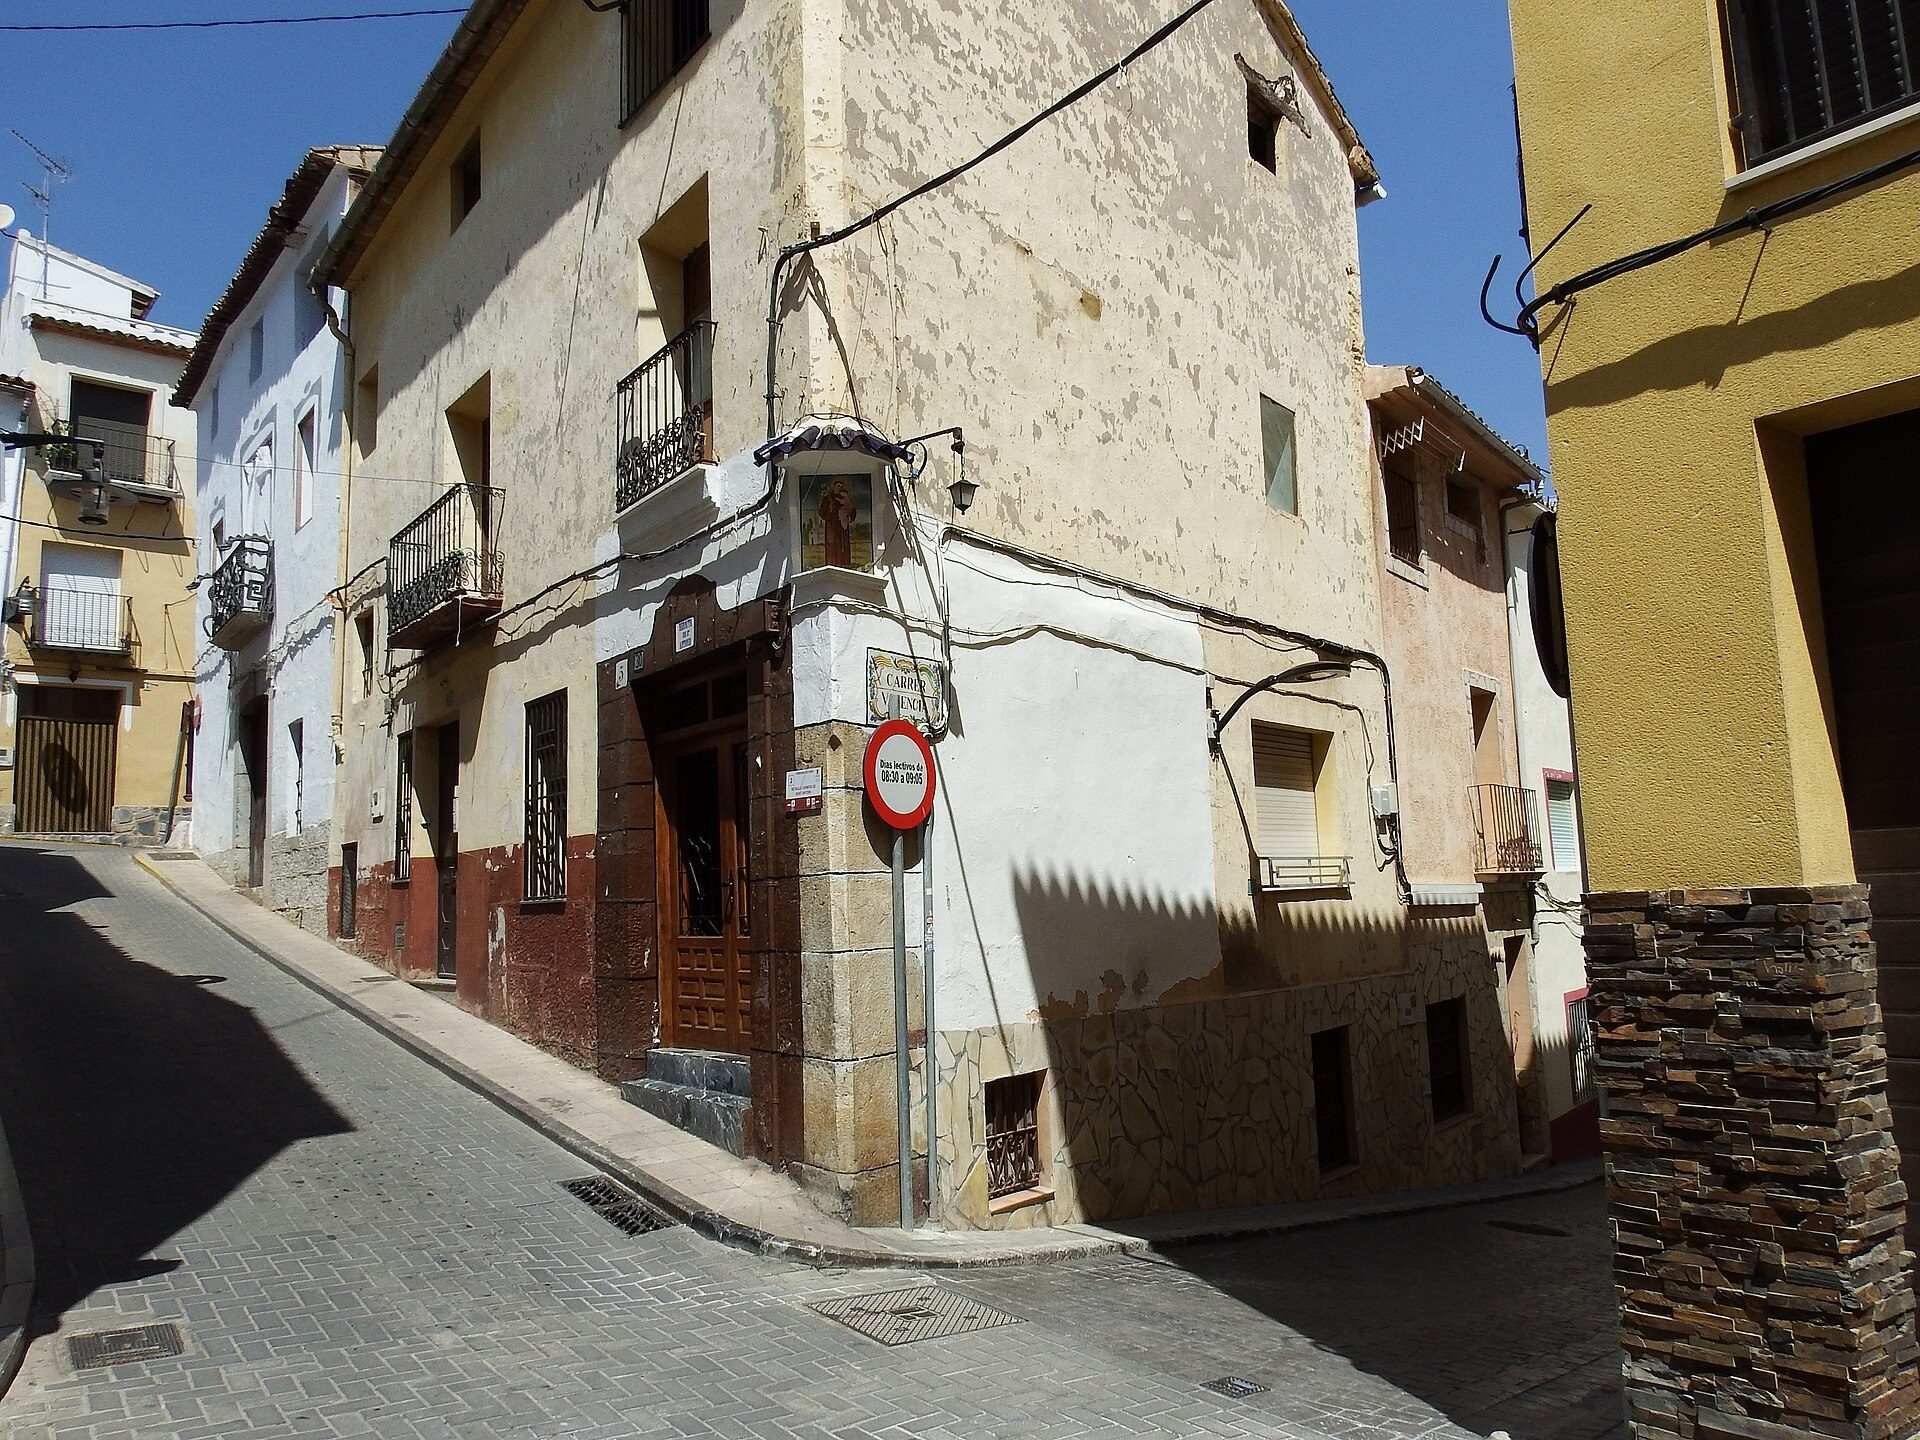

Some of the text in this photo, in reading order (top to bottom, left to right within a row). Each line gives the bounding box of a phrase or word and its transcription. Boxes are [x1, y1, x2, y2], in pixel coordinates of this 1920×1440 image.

[886, 673, 926, 693] CARRER
[881, 691, 928, 713] VENCIA
[893, 760, 916, 771] lectivos
[916, 762, 924, 772] de
[881, 769, 923, 785] 08:30 a 09:05
